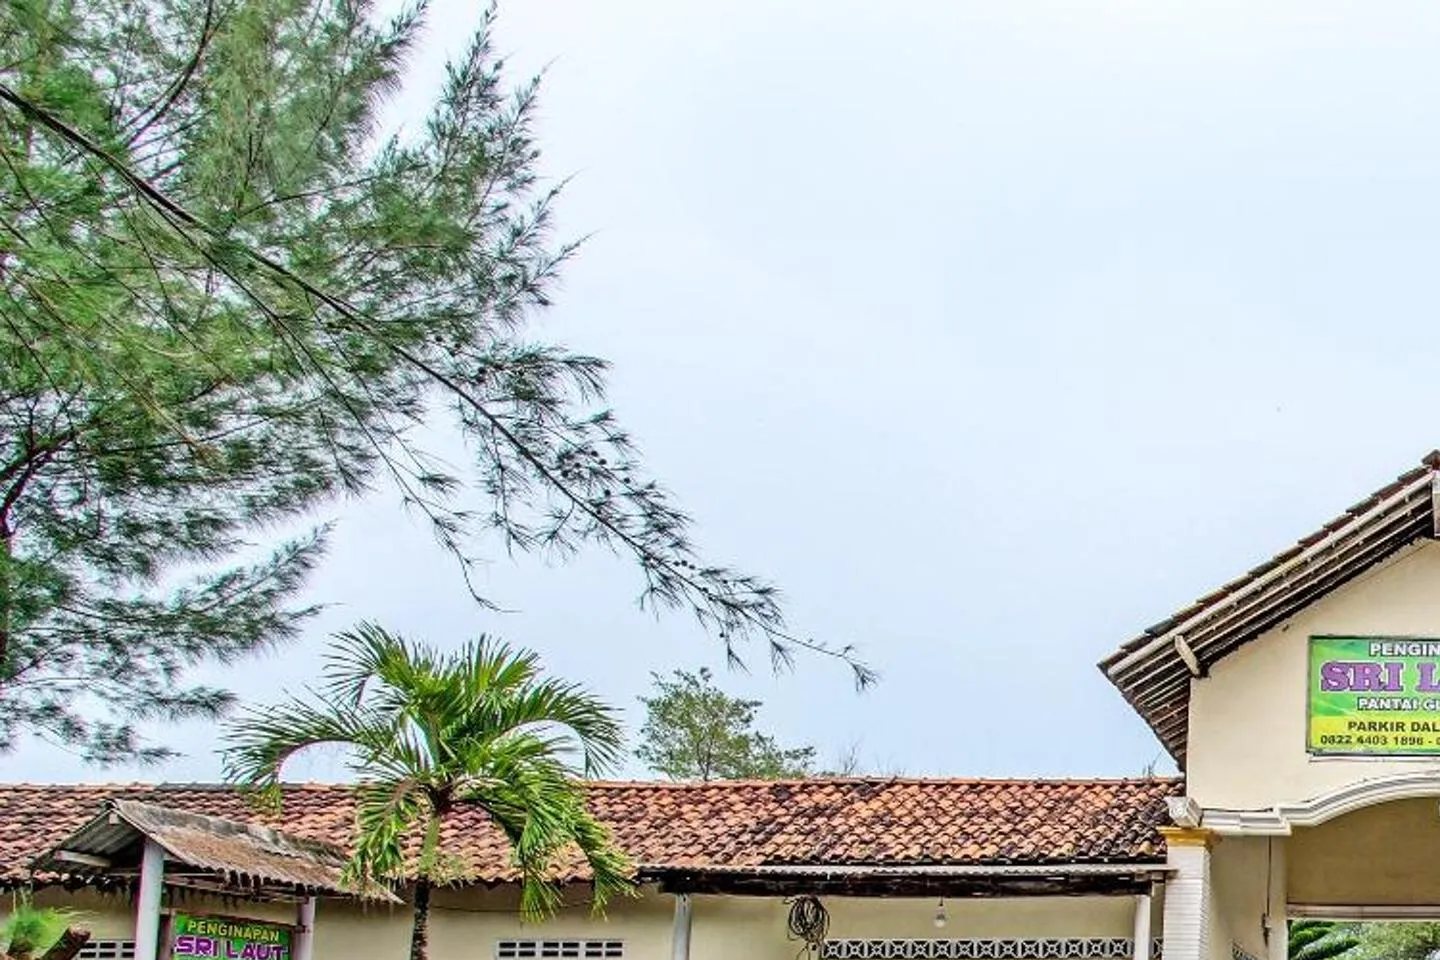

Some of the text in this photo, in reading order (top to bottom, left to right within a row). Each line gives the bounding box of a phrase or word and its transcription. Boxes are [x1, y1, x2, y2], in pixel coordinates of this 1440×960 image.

[1320, 662, 1404, 692] SRI
[1357, 698, 1417, 711] PANTAI
[1348, 721, 1405, 733] PARKIR
[1320, 735, 1353, 745] 0822
[1356, 735, 1388, 745] 4403
[187, 921, 280, 942] PENGINAPAN
[176, 936, 218, 957] SRI
